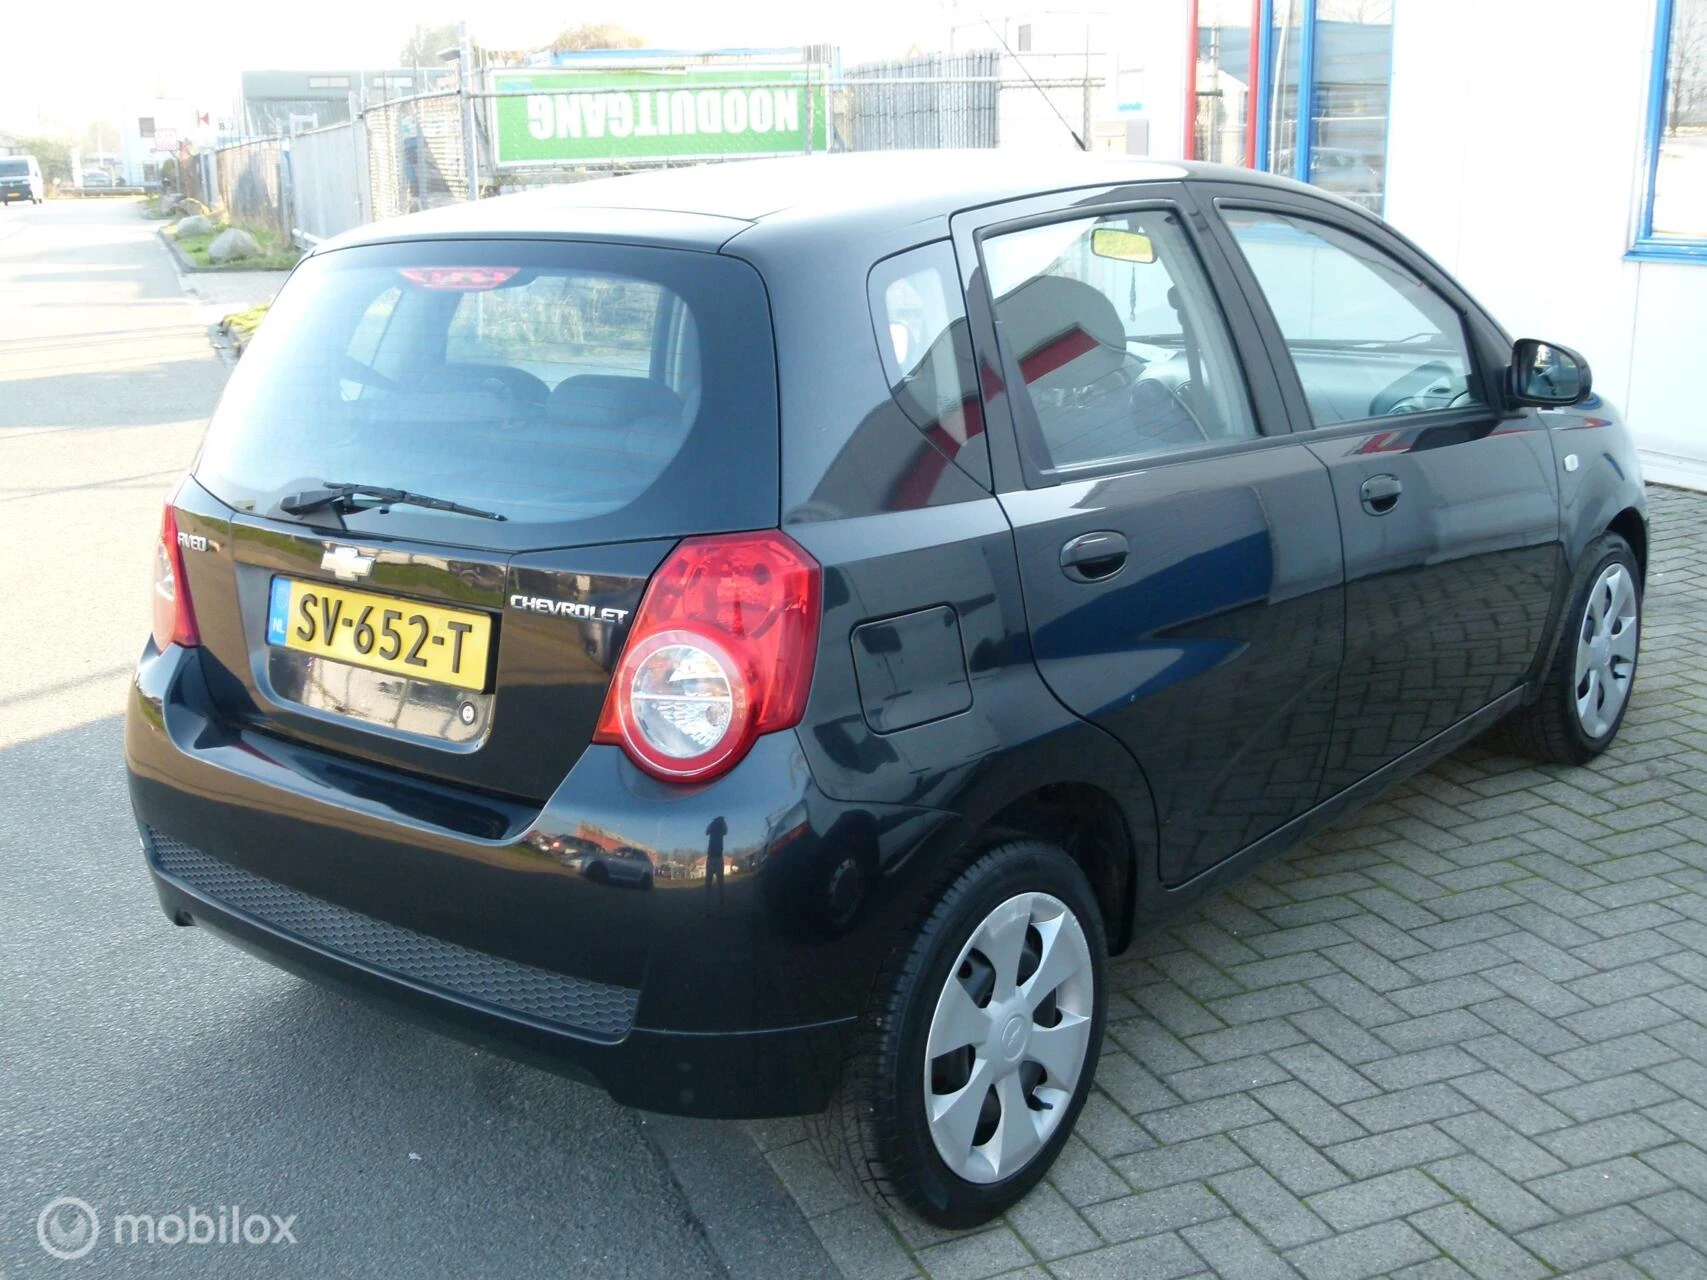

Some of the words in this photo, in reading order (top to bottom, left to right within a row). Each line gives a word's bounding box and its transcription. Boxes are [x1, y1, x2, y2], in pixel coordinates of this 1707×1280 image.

[527, 89, 798, 140] NOODUITGANG
[273, 617, 286, 633] NL
[510, 595, 629, 624] CHEVROLET
[296, 593, 473, 674] SV-652-T
